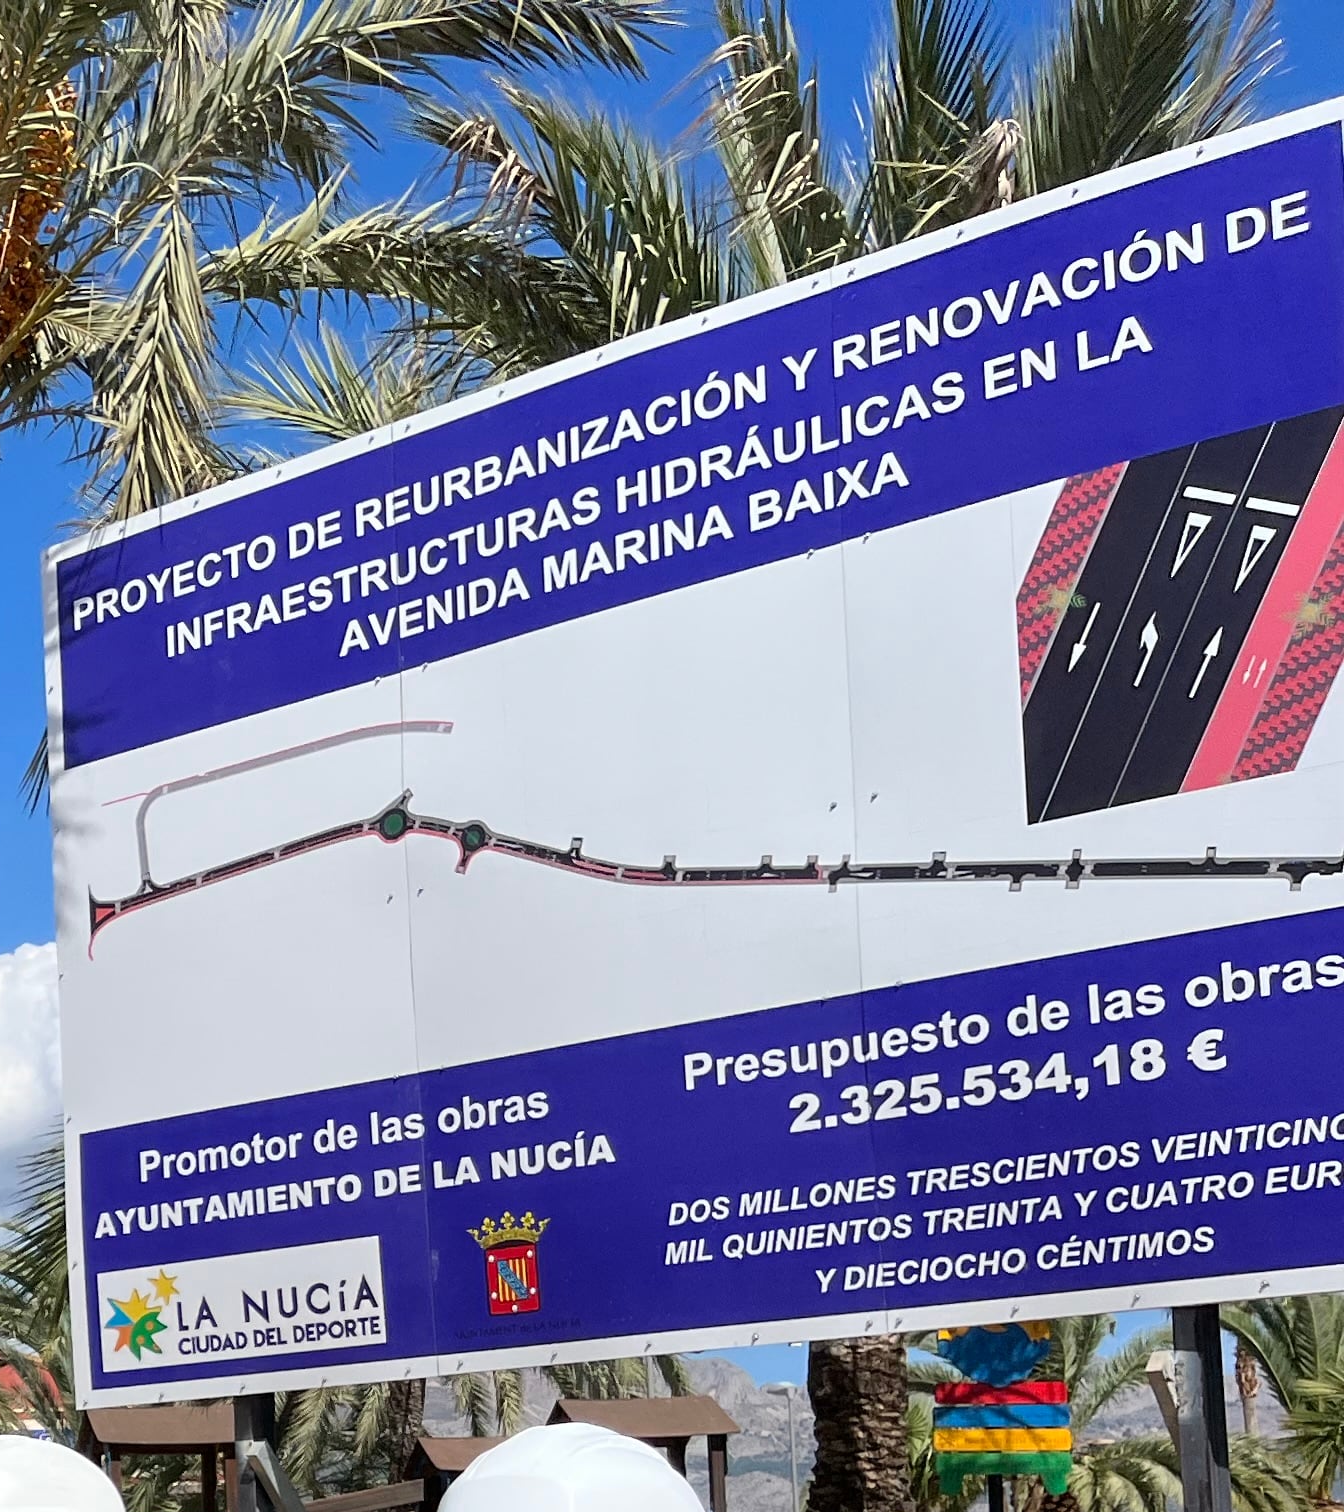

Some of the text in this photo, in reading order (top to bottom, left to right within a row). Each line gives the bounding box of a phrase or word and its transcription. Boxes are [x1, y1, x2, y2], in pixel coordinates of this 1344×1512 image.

[74, 191, 1310, 631] PROYECTO DE REURBANIZACIÓN Y RENOVACIÓN DE
[167, 316, 1153, 657] INFRAESTRUCTURAS HIDRÁULICAS EN LA
[339, 452, 909, 657] AVENIDA MARINA BAIXA
[684, 955, 1344, 1090] Presupuesto de las obras
[789, 1029, 1226, 1133] 2.325.534,18 €
[95, 1131, 616, 1238] AYUNTAMIENTO DE LA NUCÍA
[140, 1092, 549, 1182] Promotor de las obras
[669, 1197, 730, 1225] DOS
[739, 1175, 896, 1217] MILLONES
[907, 1142, 1140, 1195] TRESCIENTOS
[665, 1238, 713, 1265] MIL
[723, 1214, 912, 1259] QUINIENTOS
[923, 1196, 1062, 1235] TREINTA
[1074, 1190, 1097, 1216] Y
[1106, 1172, 1254, 1212] CUATRO
[816, 1227, 1214, 1293] Y DIECIOCHO CÉNTIMOS
[177, 1296, 218, 1331] LA
[178, 1315, 381, 1355] CIUDAD DEL DEPORTE
